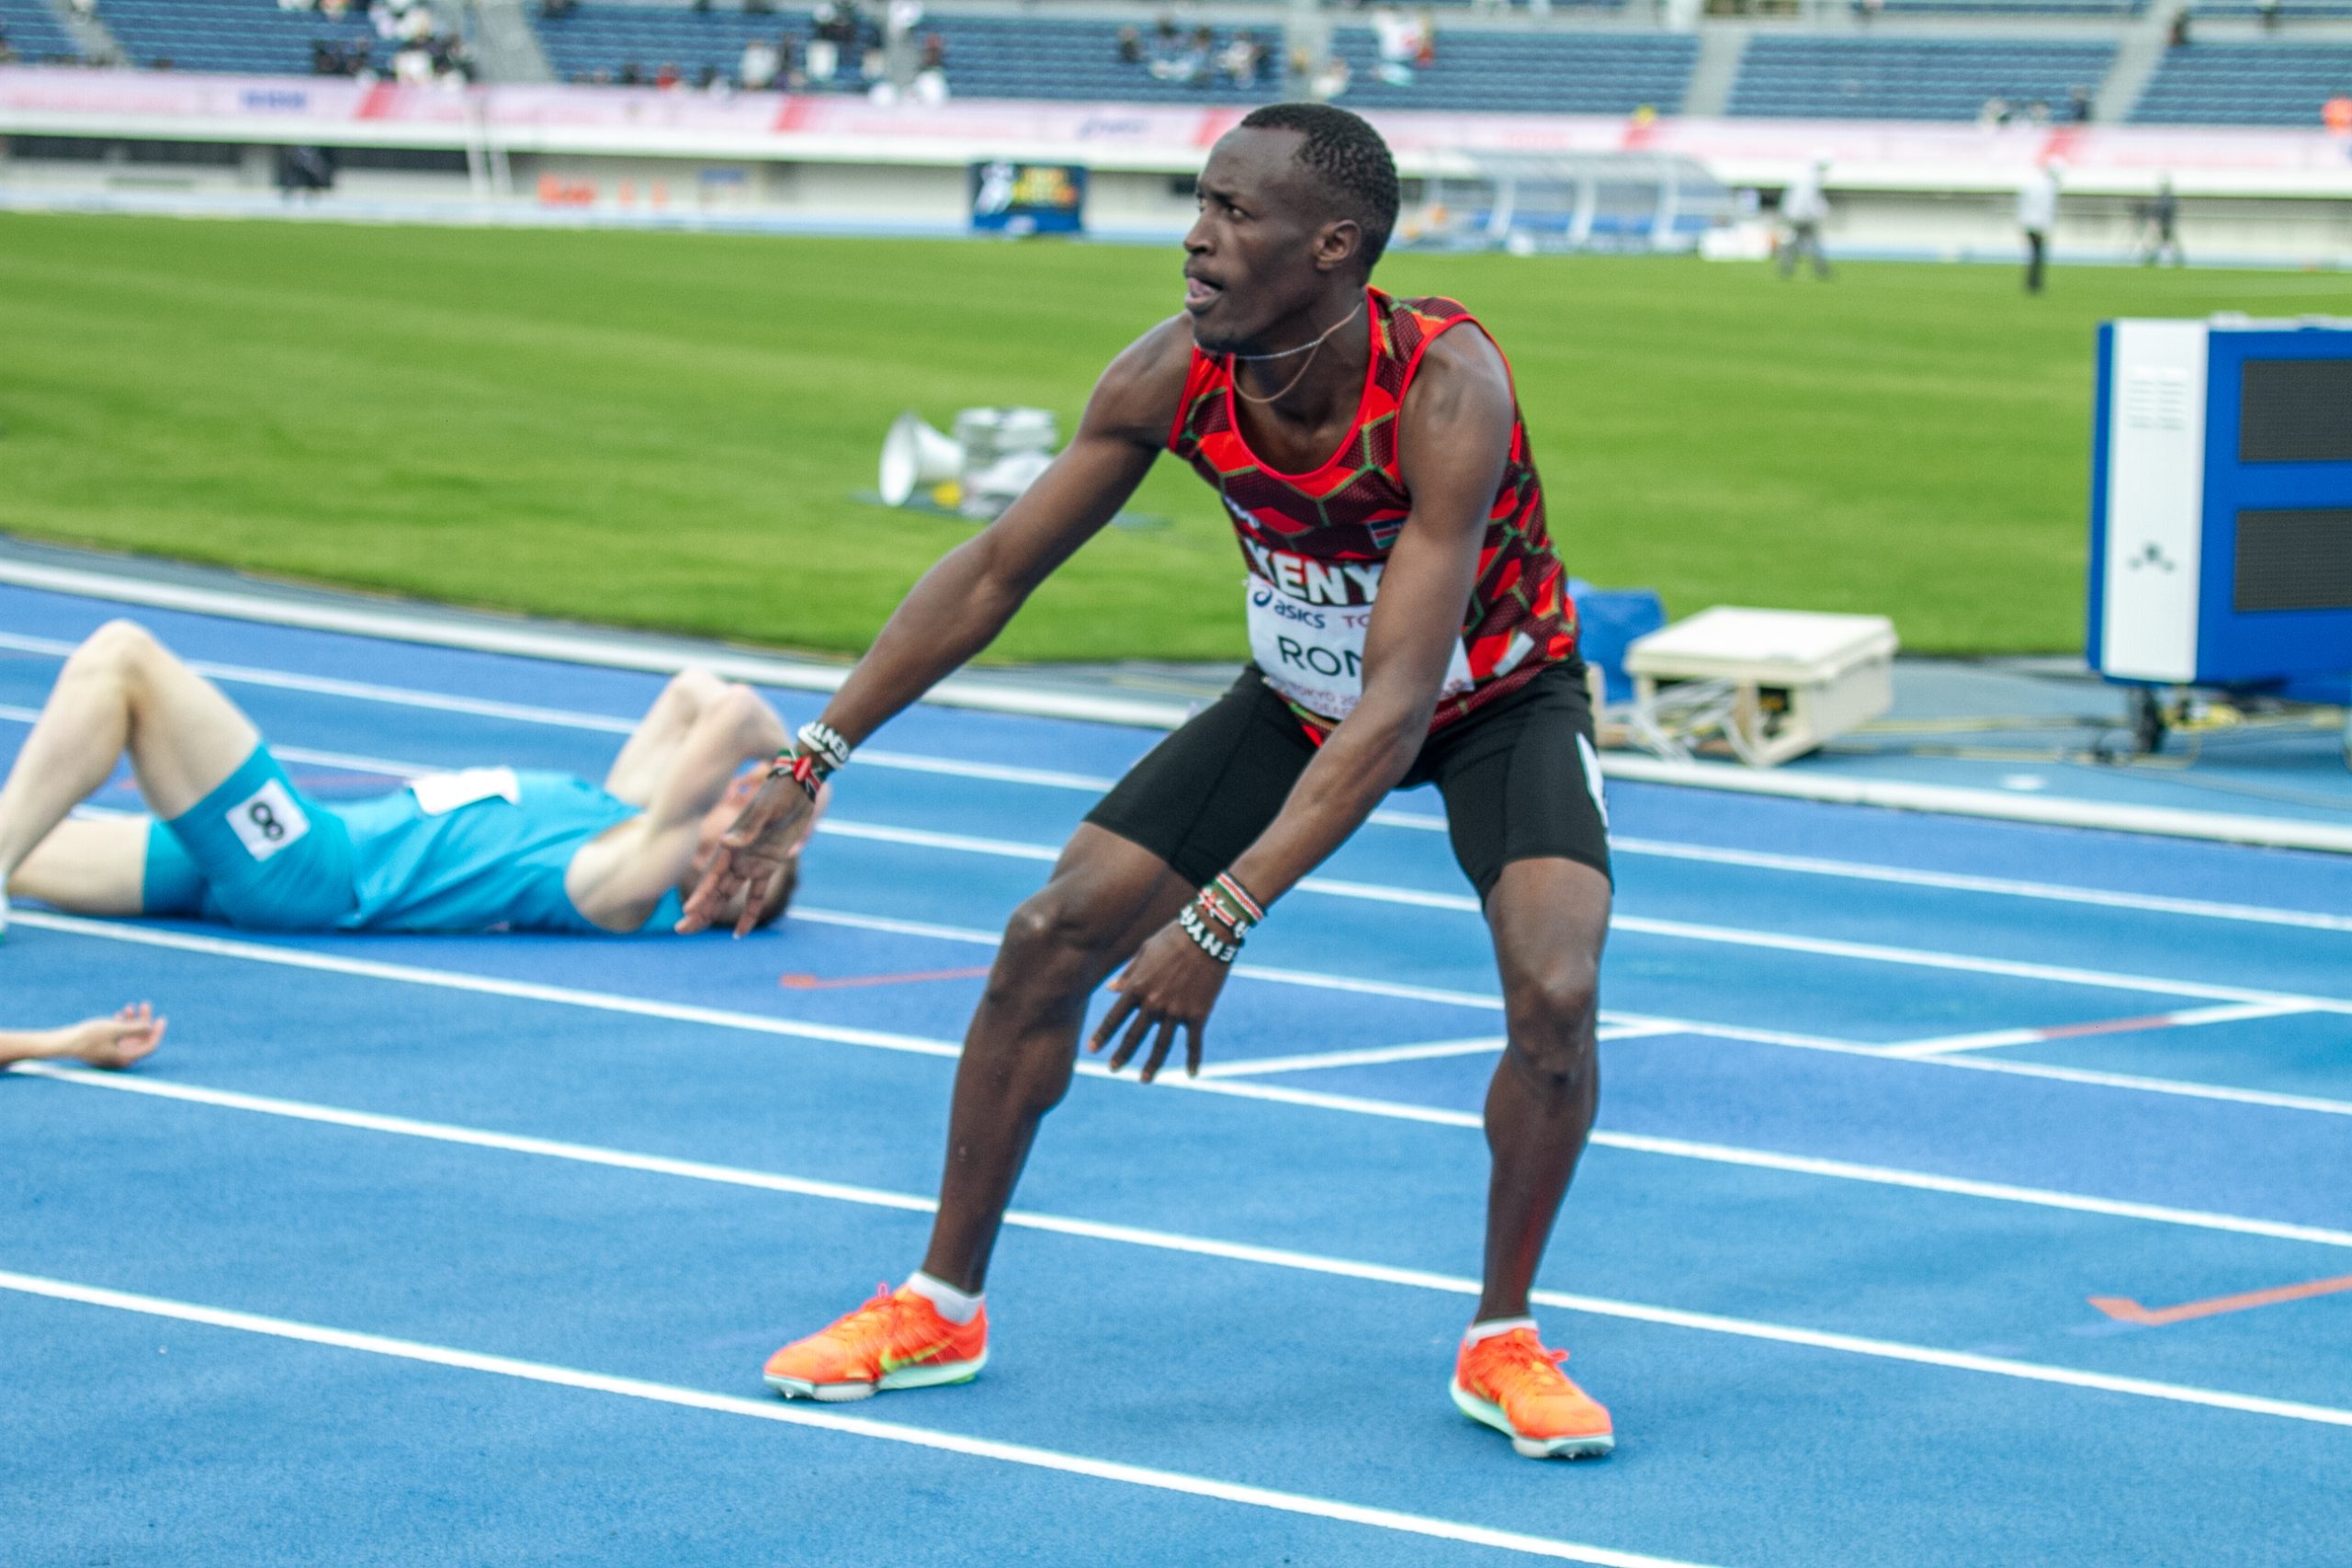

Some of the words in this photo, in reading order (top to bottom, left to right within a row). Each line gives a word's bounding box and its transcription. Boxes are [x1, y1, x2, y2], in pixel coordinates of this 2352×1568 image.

[1244, 536, 1385, 605] KENY
[1274, 599, 1326, 629] asics
[248, 801, 284, 841] 8
[1180, 905, 1237, 962] ENYA
